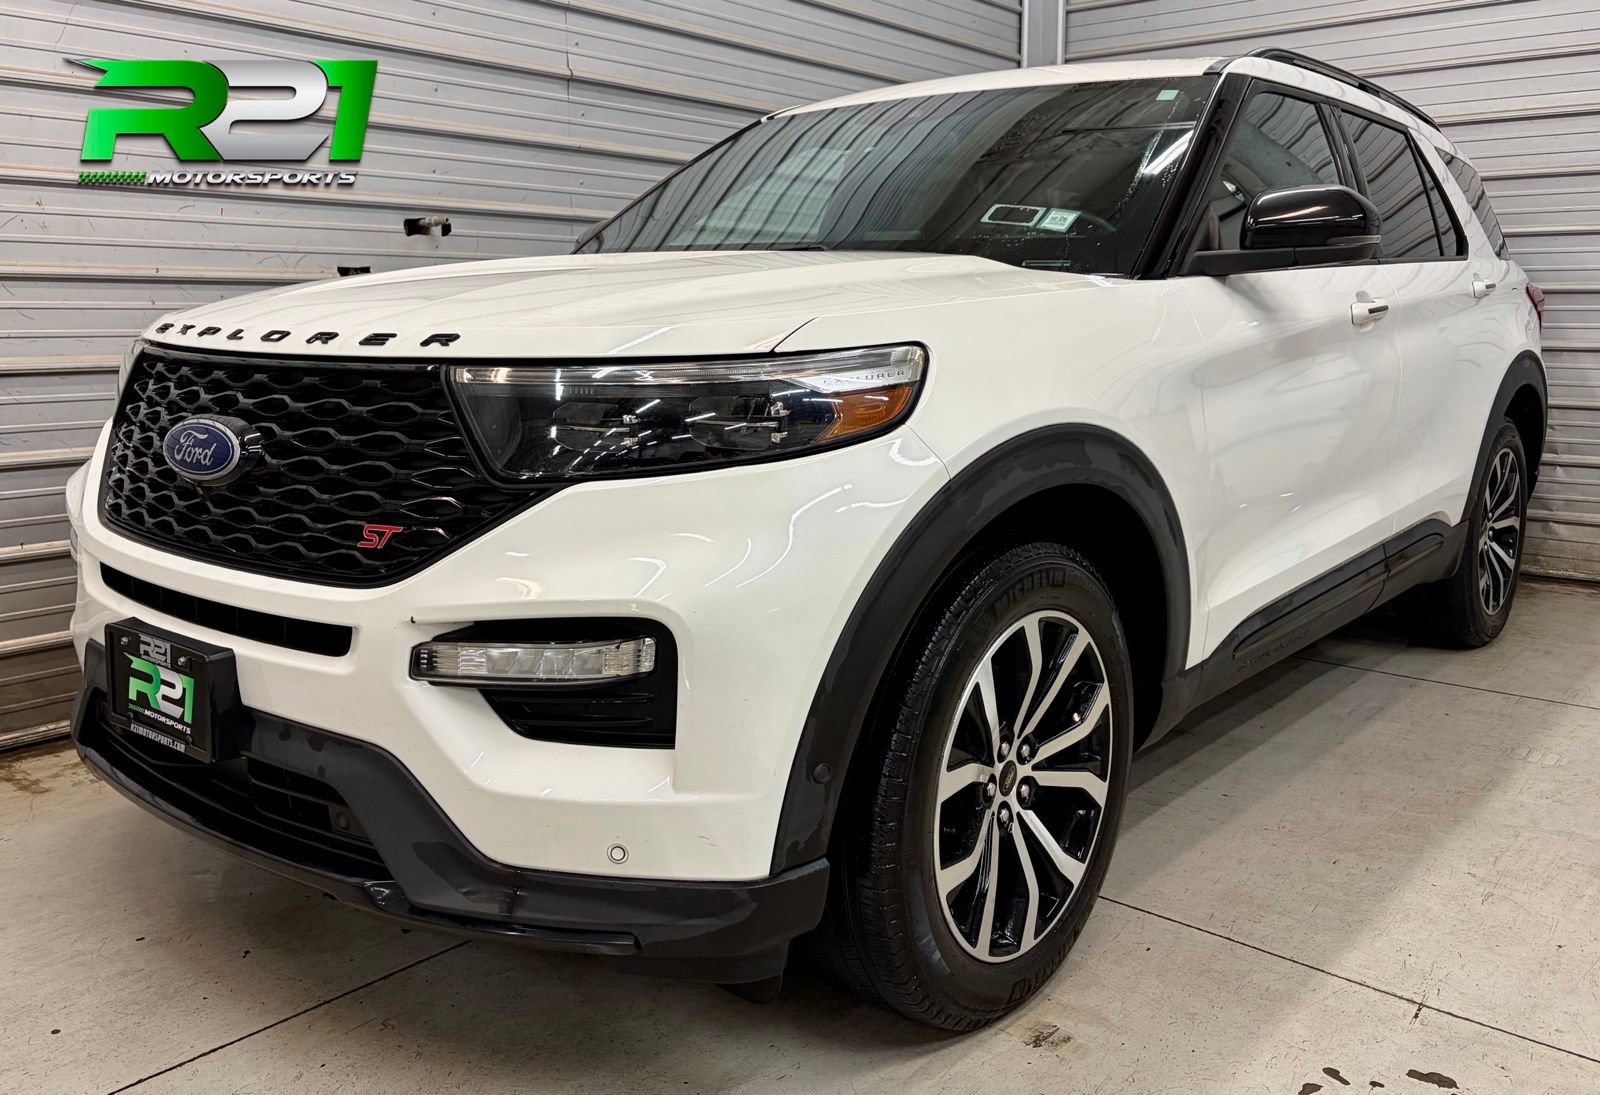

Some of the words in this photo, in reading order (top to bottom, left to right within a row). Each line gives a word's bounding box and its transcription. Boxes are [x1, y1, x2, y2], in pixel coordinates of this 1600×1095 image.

[155, 322, 461, 347] EXPLORER
[174, 429, 215, 467] Ford
[357, 524, 403, 549] ST
[138, 633, 172, 668] R21
[122, 651, 195, 725] R21
[144, 708, 192, 735] MOTORSPORTS
